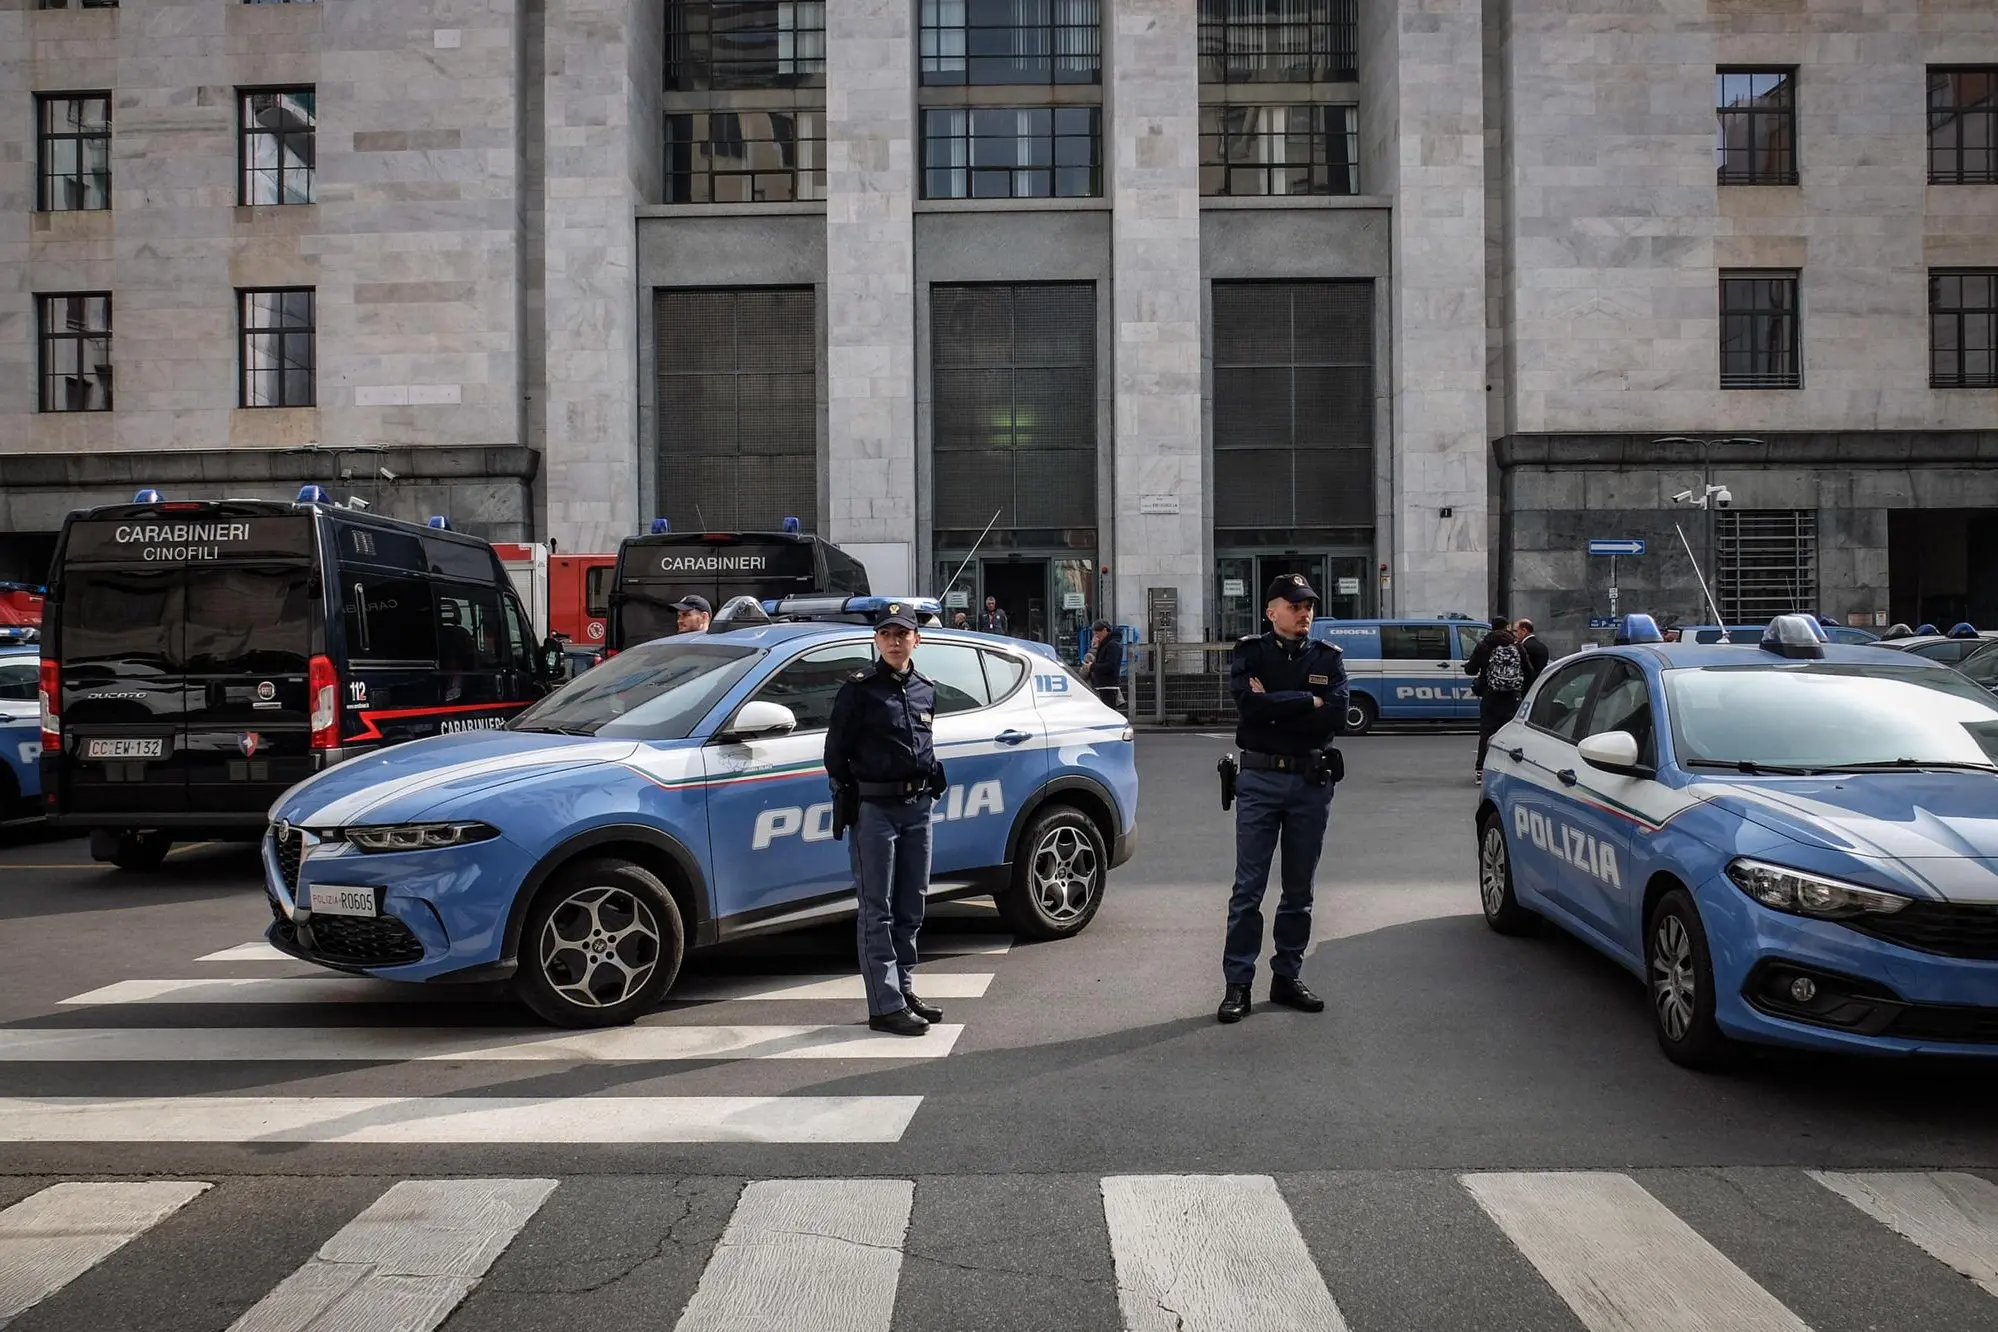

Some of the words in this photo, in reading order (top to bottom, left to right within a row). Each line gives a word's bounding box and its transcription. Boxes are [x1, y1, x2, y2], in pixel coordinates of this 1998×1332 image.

[115, 523, 250, 543] CARABINIERI
[143, 546, 219, 561] CINOFILI
[661, 556, 766, 571] CARABINIERI
[1034, 674, 1069, 692] 113
[87, 692, 147, 700] DUCATO
[349, 681, 367, 701] 112
[1396, 687, 1483, 700] POLIZ
[1514, 803, 1622, 890] POLIZIA
[312, 894, 339, 905] POLIZIA
